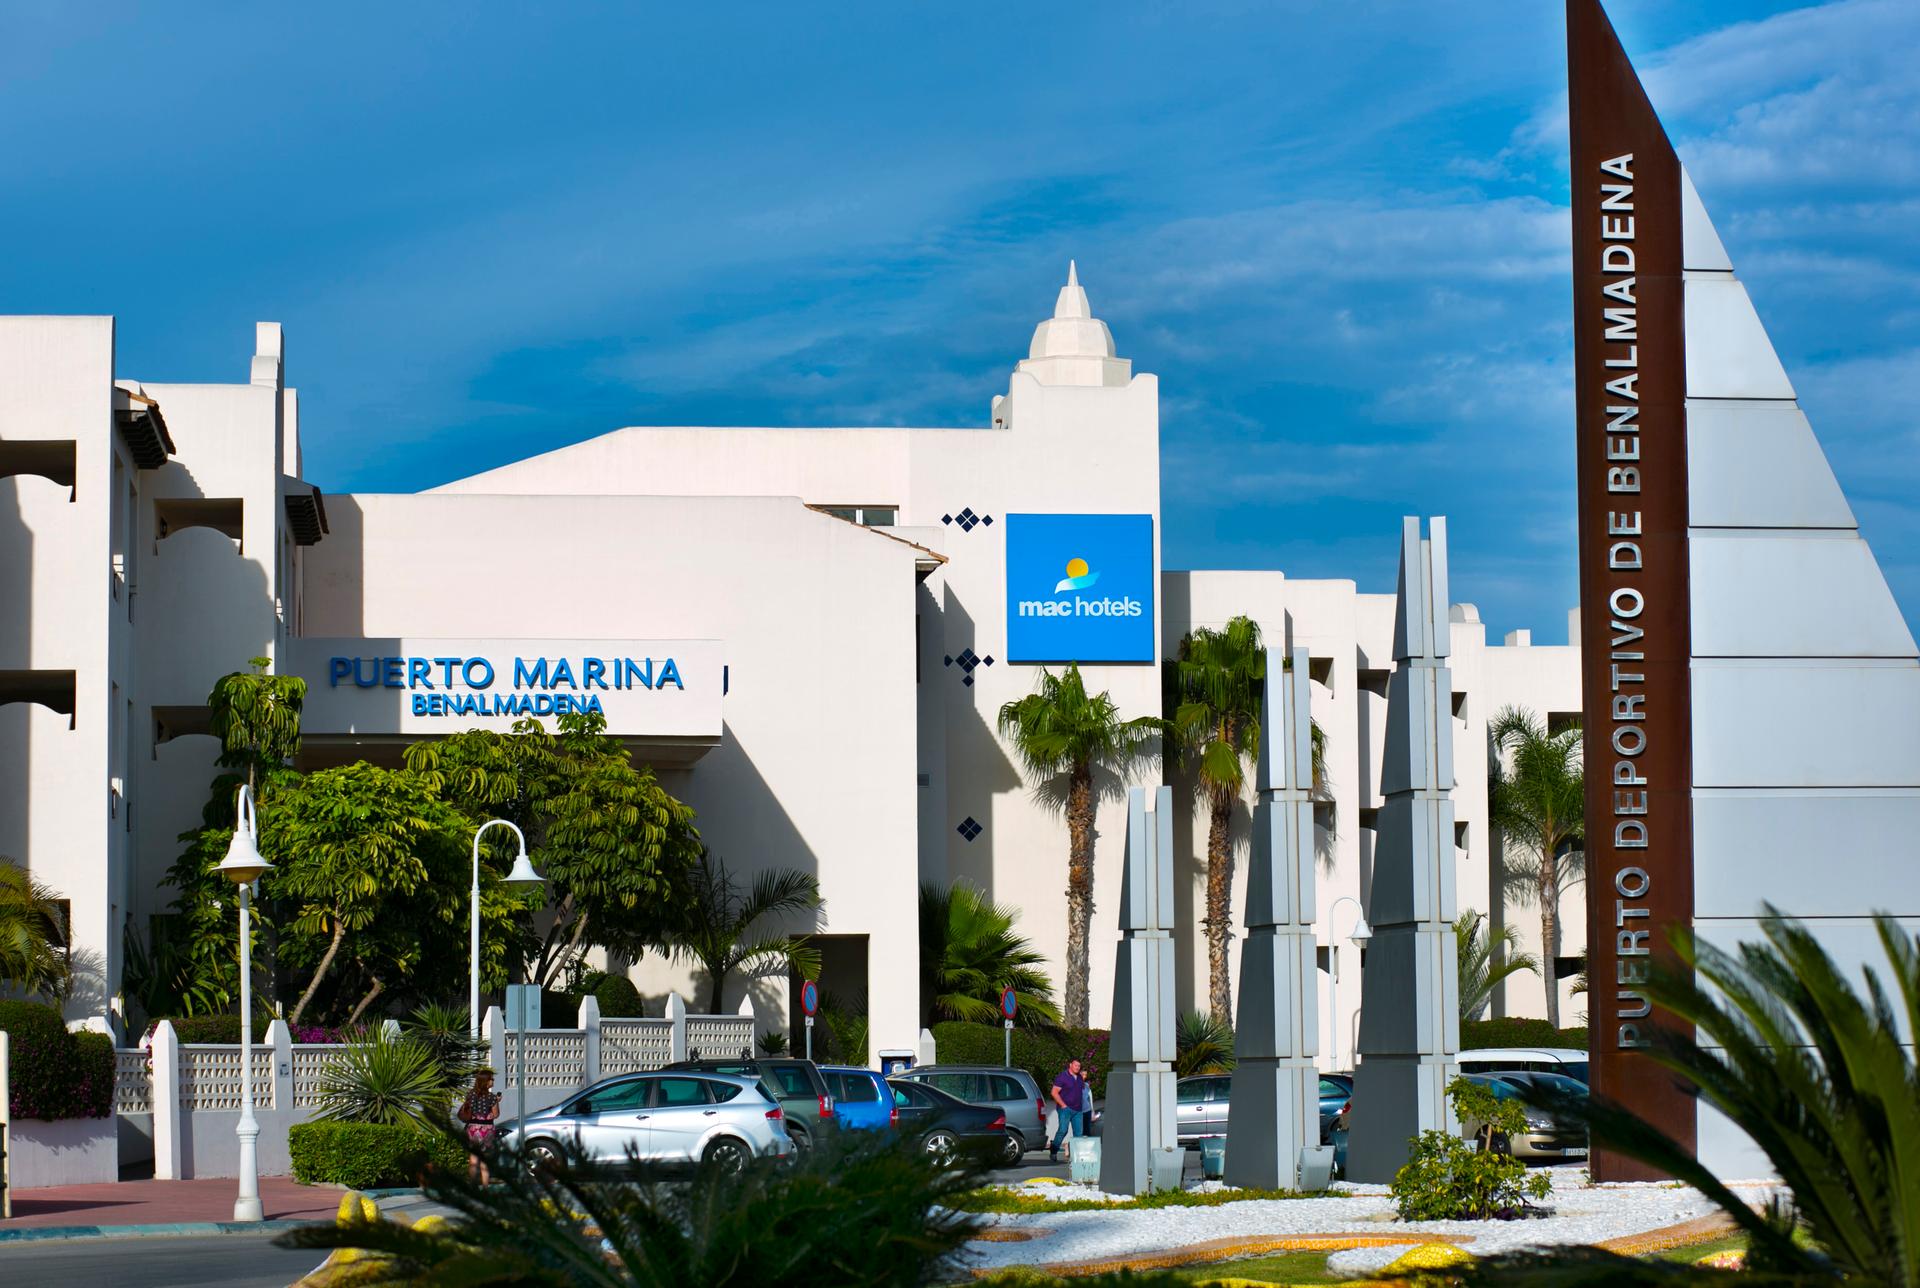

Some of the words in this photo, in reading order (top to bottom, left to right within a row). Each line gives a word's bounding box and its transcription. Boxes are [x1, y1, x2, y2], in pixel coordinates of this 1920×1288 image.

[1601, 153, 1641, 492] BENALMADENA
[1609, 511, 1643, 569] DE
[1019, 600, 1072, 617] mac
[1075, 596, 1142, 617] hotels
[330, 656, 495, 689] PUERTO
[514, 656, 684, 690] MARINA
[412, 693, 604, 716] BENALMADENA
[1610, 587, 1648, 849] DEPORTIVO
[1616, 865, 1651, 1048] PUERTO
